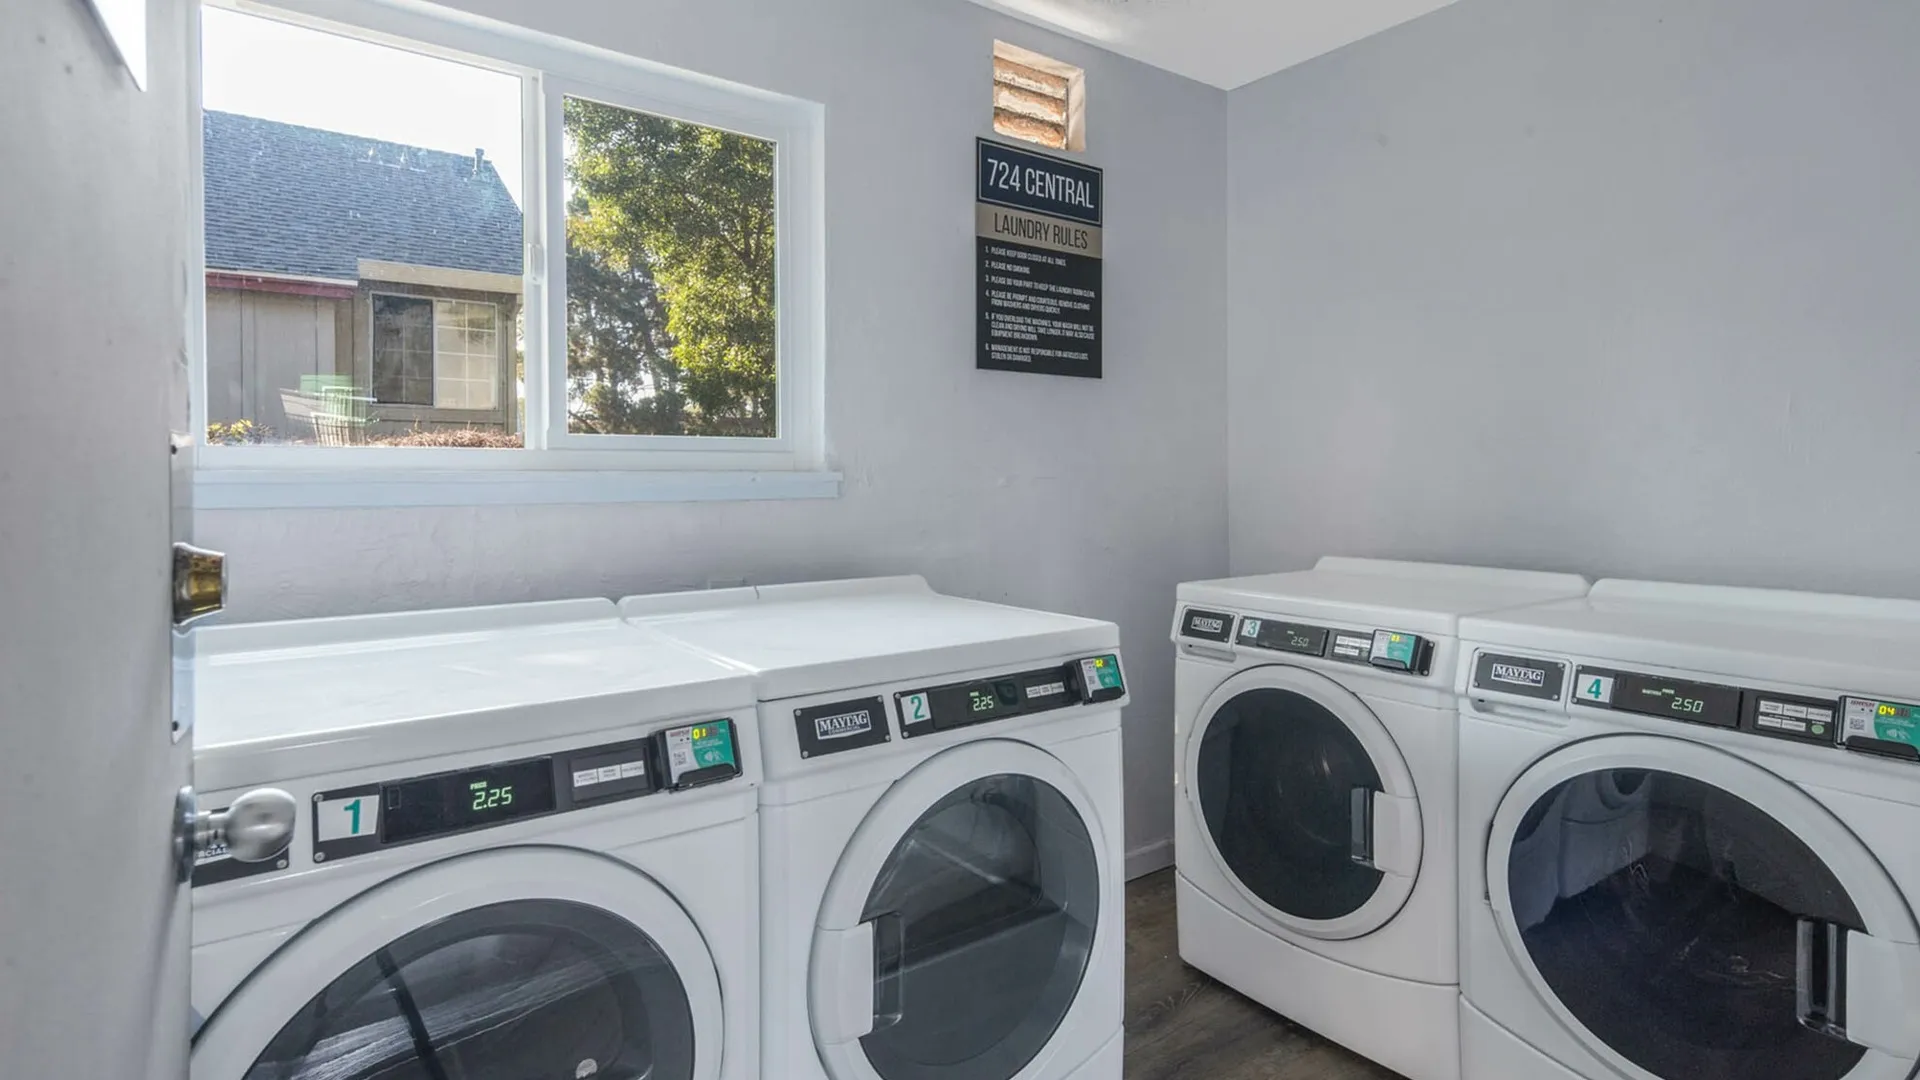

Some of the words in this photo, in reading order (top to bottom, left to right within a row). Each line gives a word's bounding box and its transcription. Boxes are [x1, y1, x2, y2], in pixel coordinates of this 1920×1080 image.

[987, 158, 1021, 192] 724
[1025, 167, 1095, 209] CENTRAL
[994, 212, 1050, 242] LAUNDRY
[1053, 224, 1088, 250] RULES
[1247, 620, 1257, 636] 3
[1495, 665, 1542, 681] MAYTAG
[1587, 678, 1602, 699] 4
[910, 696, 926, 720] 2
[973, 695, 994, 711] 2.25
[1671, 696, 1704, 713] 2.50
[1879, 704, 1896, 716] 04
[819, 713, 868, 733] MAYTAG
[693, 728, 707, 740] 01
[472, 786, 512, 810] 2.25
[343, 799, 361, 835] 1
